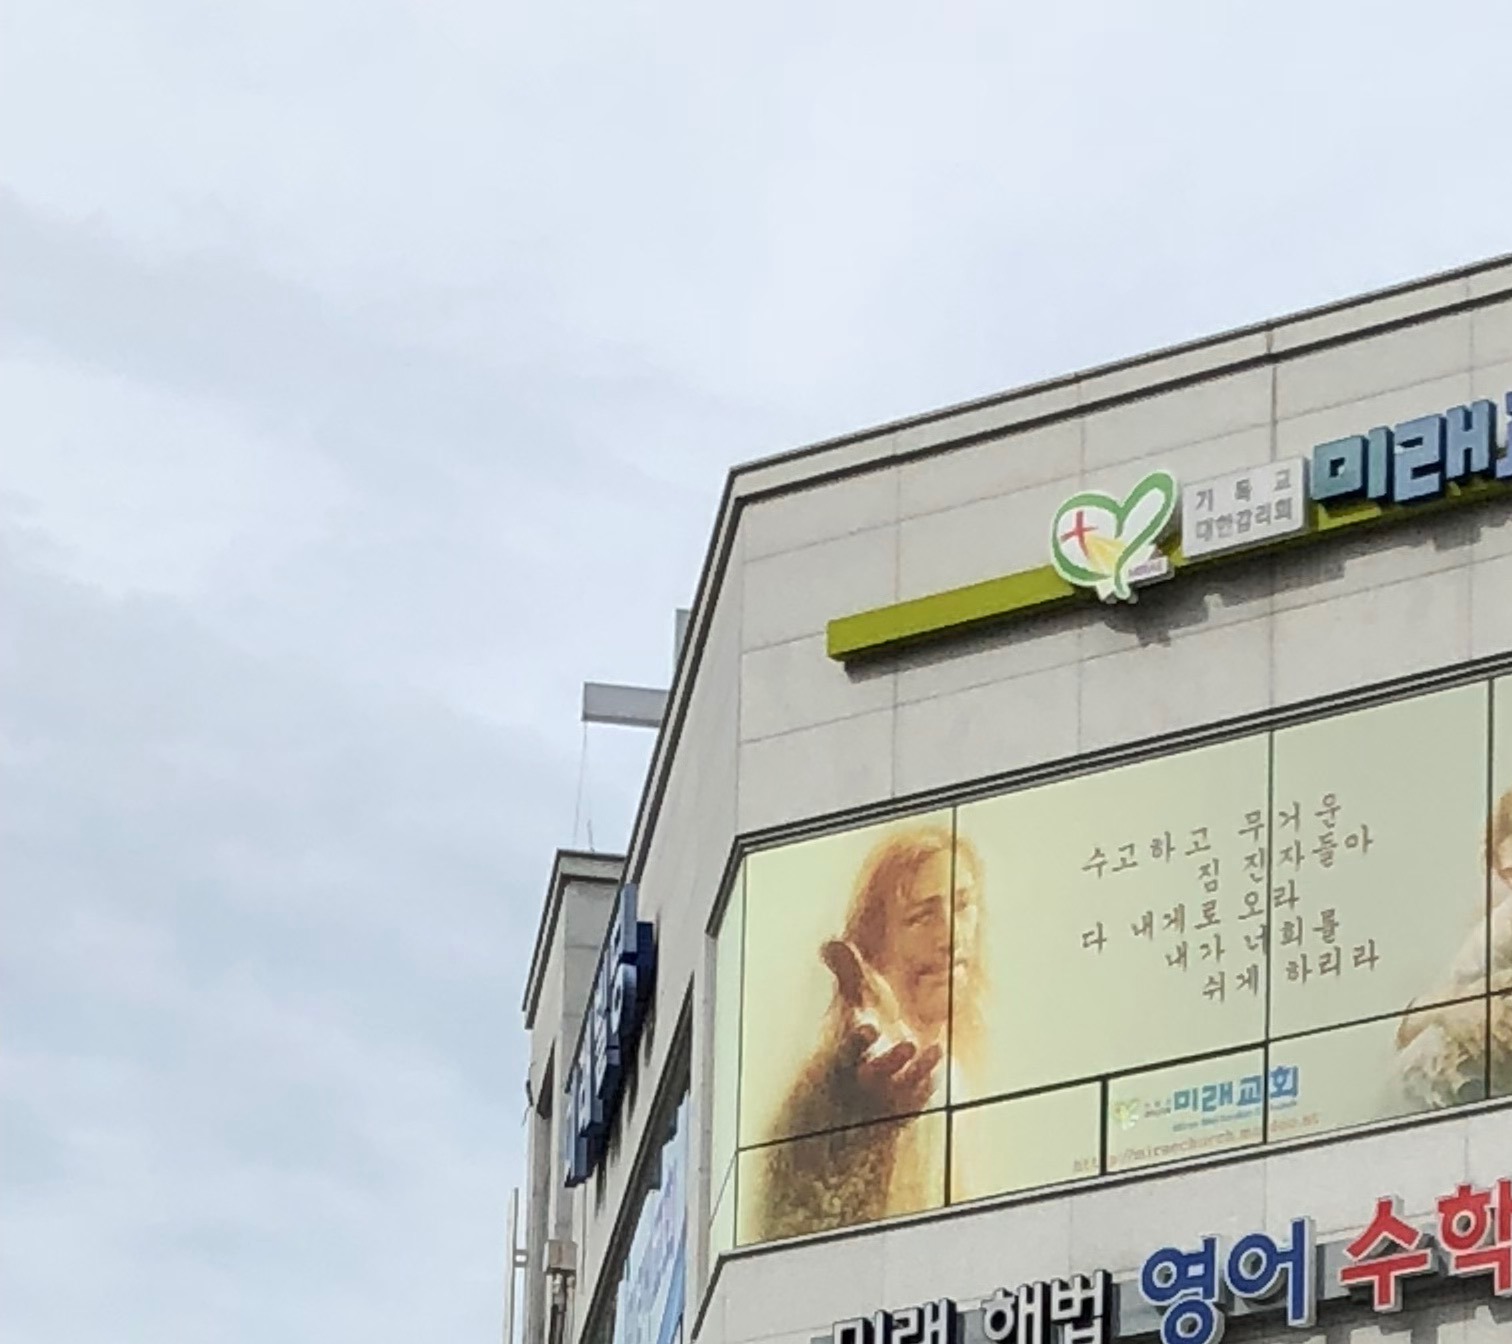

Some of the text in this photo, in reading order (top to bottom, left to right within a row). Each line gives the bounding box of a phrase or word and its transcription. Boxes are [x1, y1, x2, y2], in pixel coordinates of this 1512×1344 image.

[1196, 497, 1292, 541] 대한감리회
[1082, 793, 1342, 878] 수고하고 무거운
[1199, 824, 1374, 892] 짐 진 자들아
[1082, 879, 1300, 954] 다 내게로 오라
[1165, 908, 1340, 972] 내가 너희를
[1202, 939, 1379, 1003] 쉬게 하리라
[1174, 1065, 1298, 1113] 미래교회
